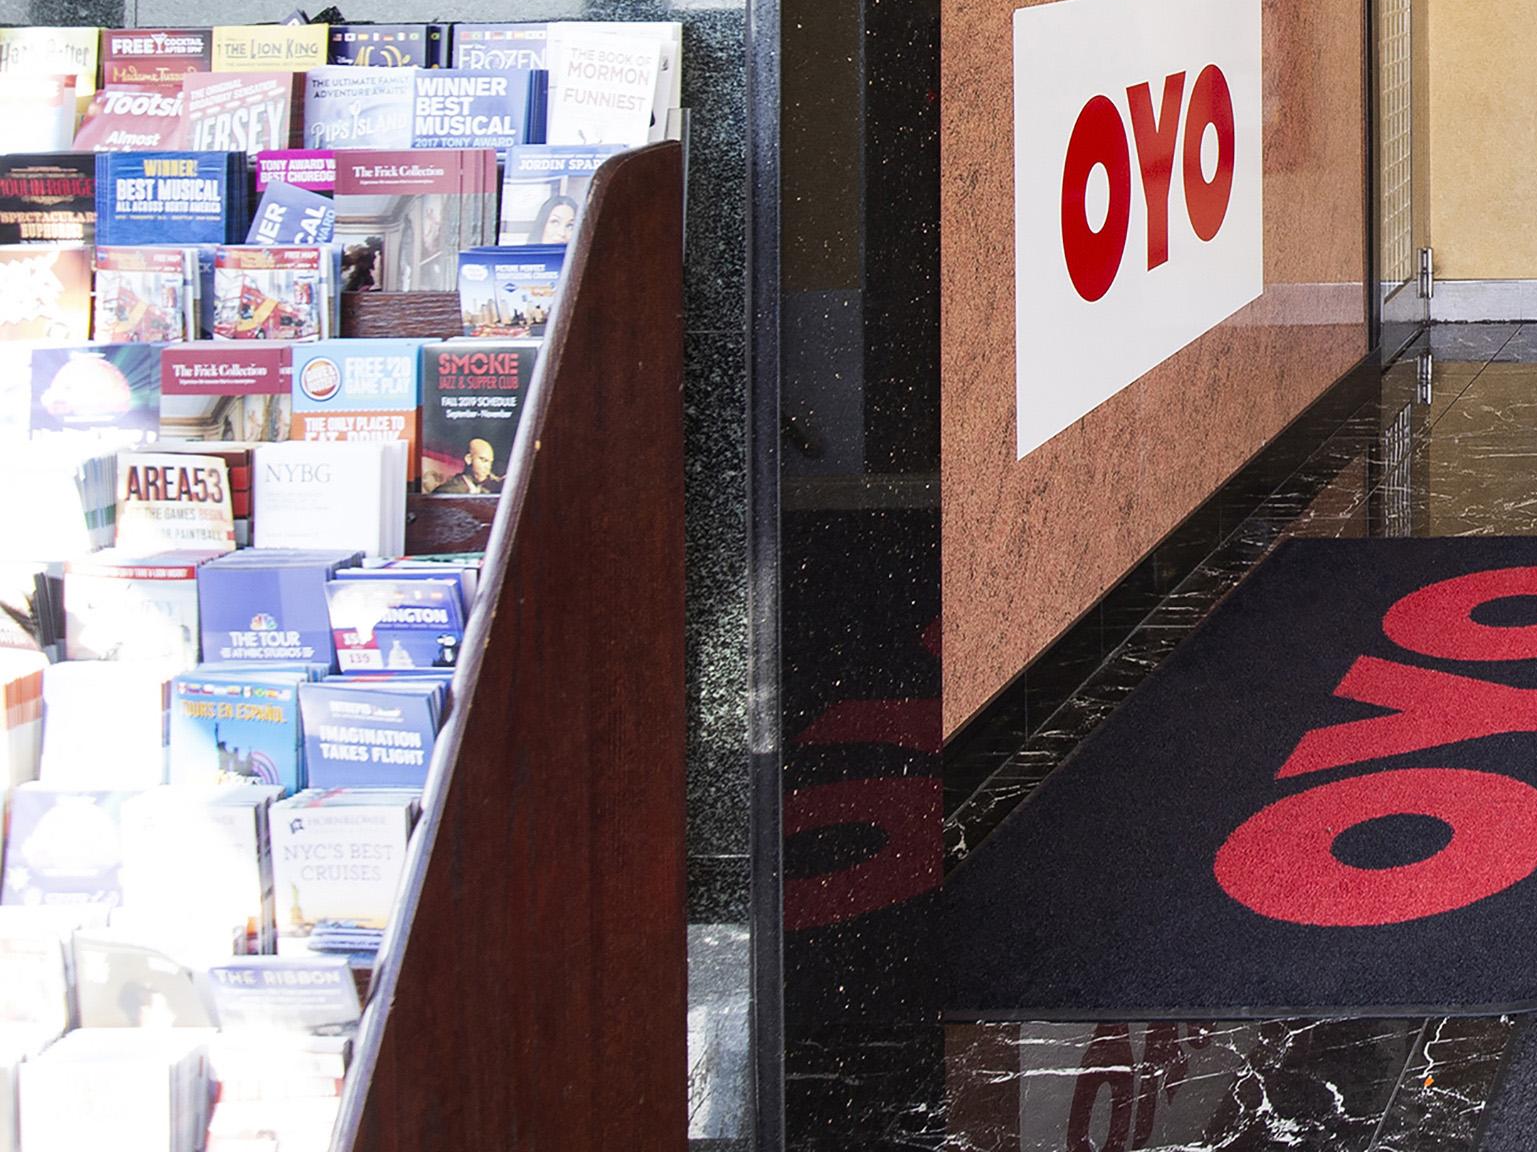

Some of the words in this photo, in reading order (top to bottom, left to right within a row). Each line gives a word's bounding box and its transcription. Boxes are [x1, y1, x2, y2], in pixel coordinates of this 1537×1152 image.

[112, 38, 153, 55] FREE
[226, 43, 247, 59] THE
[250, 38, 282, 60] LION
[285, 38, 319, 59] KING
[458, 48, 548, 70] FROZEN
[570, 48, 596, 60] THE
[598, 50, 634, 65] BOOK
[636, 55, 653, 67] OF
[312, 78, 330, 88] THE
[331, 77, 377, 87] ULTIMATE
[567, 61, 650, 86] MORMON
[314, 88, 370, 99] ADVENTURE
[415, 77, 508, 98] WINNER
[103, 91, 184, 116] Tootsi
[415, 97, 474, 116] BEST
[563, 88, 647, 112] FUNNIEST
[415, 116, 517, 137] MUSICAL
[105, 130, 161, 146] Almost
[415, 137, 437, 148] 2017
[438, 137, 470, 148] TONY
[472, 137, 515, 148] AWARD
[260, 158, 287, 171] TONY
[288, 158, 325, 171] AWARD
[352, 165, 373, 177] The
[374, 164, 398, 177] Frick
[398, 163, 445, 177] Collection
[518, 158, 565, 171] JORDIN
[260, 171, 286, 183] BEST
[1060, 63, 1236, 303] OYO
[116, 179, 156, 200] BEST
[157, 179, 221, 201] MUSICAL
[115, 200, 131, 213] ALL
[132, 200, 164, 213] ACROSS
[172, 364, 194, 377] The
[194, 363, 218, 377] Frick
[218, 363, 268, 377] Collection
[345, 357, 385, 378] FREE
[438, 352, 519, 375] SMOKE
[438, 376, 457, 389] JAZZ
[457, 376, 465, 389] &
[466, 376, 497, 389] SUPPER
[498, 376, 519, 389] CLUB
[441, 396, 458, 406] FALL
[476, 396, 518, 406] SCHEDULE
[304, 417, 327, 431] THE
[356, 416, 391, 431] PLACE
[391, 416, 405, 431] TO
[264, 463, 332, 483] NYBG
[125, 465, 224, 504] AREA53
[144, 507, 162, 521] THE
[164, 507, 196, 521] GAMES
[174, 527, 223, 542] PAINTBALL
[229, 631, 259, 647] THE
[259, 631, 302, 647] TOUR
[182, 701, 216, 718] TOURS
[217, 702, 234, 719] EN
[319, 725, 422, 748] IMAGINATION
[319, 743, 369, 762] TAKES
[371, 746, 425, 766] FLIGHT
[283, 843, 345, 861] NYC'S
[349, 842, 394, 861] BEST
[300, 864, 382, 882] CRUISES
[216, 970, 257, 985] THE
[263, 969, 341, 985] RIBBON
